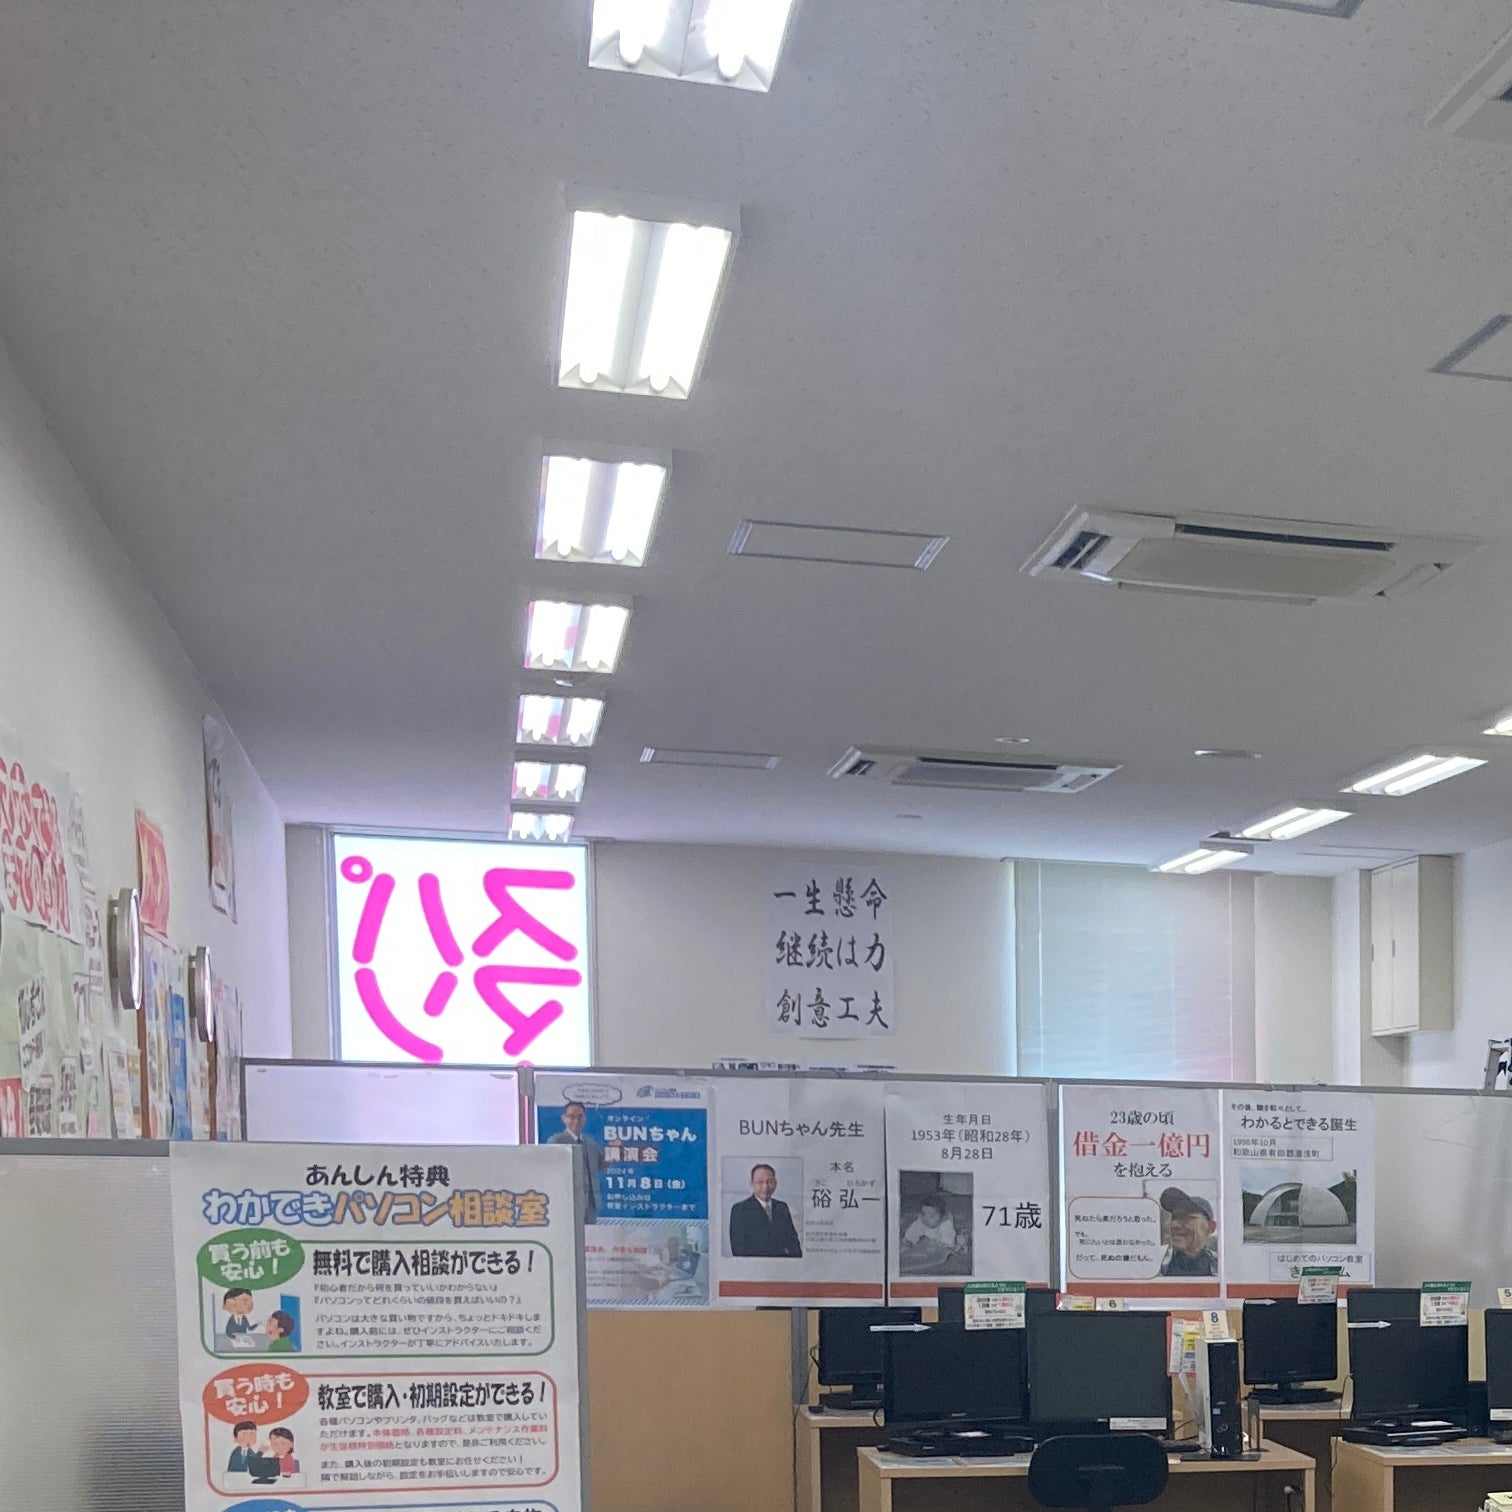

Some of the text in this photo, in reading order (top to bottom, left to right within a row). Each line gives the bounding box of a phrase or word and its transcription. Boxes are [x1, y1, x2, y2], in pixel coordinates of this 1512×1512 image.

[774, 877, 887, 920] 一生懸命
[776, 930, 885, 972] 継続は力
[777, 987, 889, 1028] 創意工夫
[944, 1114, 992, 1126] 生年月日
[1110, 1110, 1175, 1126] 23歳の頃
[1241, 1115, 1357, 1131] わかるとできる誕生
[604, 1125, 697, 1142] BUNちゃん
[740, 1120, 864, 1137] BUNちゃん先生
[941, 1147, 993, 1160] 8月28日
[1074, 1131, 1210, 1158] 借金一億円
[306, 1165, 450, 1188] あんしん特典
[830, 1162, 854, 1173] 本名
[1114, 1162, 1173, 1178] を抱える
[202, 1188, 550, 1228] わかできパソコン相談室
[840, 1189, 881, 1209] 弘一
[982, 1202, 1042, 1229] 71歳
[209, 1239, 290, 1264] 買う前も
[1277, 1254, 1363, 1264] はじめてのパソコン教室
[312, 1249, 534, 1276] 無料で購入相談ができる！
[1504, 1288, 1512, 1297] 5
[1211, 1312, 1218, 1323] 8
[214, 1372, 295, 1399] 買う時も
[317, 1382, 546, 1411] 教室で購入・初期設定ができる！
